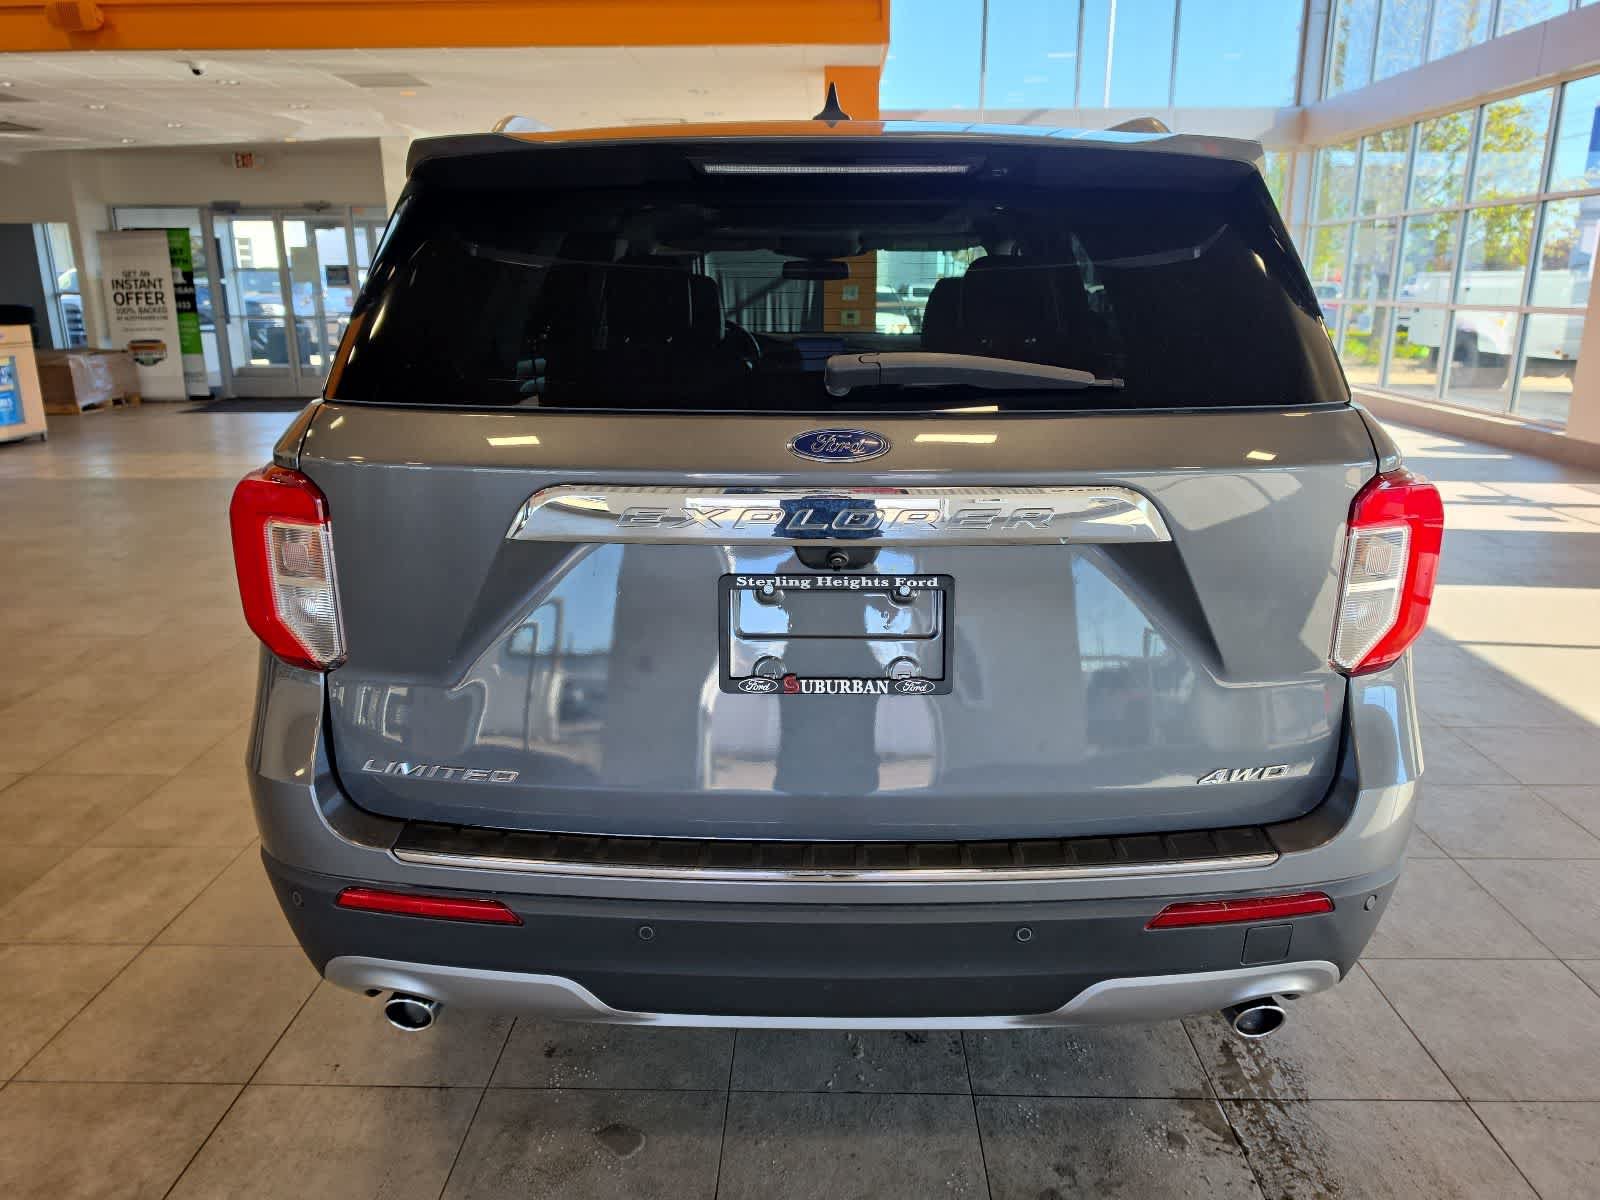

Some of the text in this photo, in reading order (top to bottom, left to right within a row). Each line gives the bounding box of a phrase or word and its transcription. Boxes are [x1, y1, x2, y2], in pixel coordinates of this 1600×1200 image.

[234, 152, 254, 168] EXIT
[121, 270, 137, 278] GET
[112, 279, 163, 290] INSTANT
[113, 291, 166, 306] OFFER
[811, 434, 866, 454] Ford
[615, 506, 1057, 530] EXPLORER
[736, 576, 938, 590] Sterling Heights Ford
[745, 673, 928, 694] Ford SUBURBAN Ford
[361, 759, 520, 784] LIMITED
[1197, 764, 1290, 785] AWD
